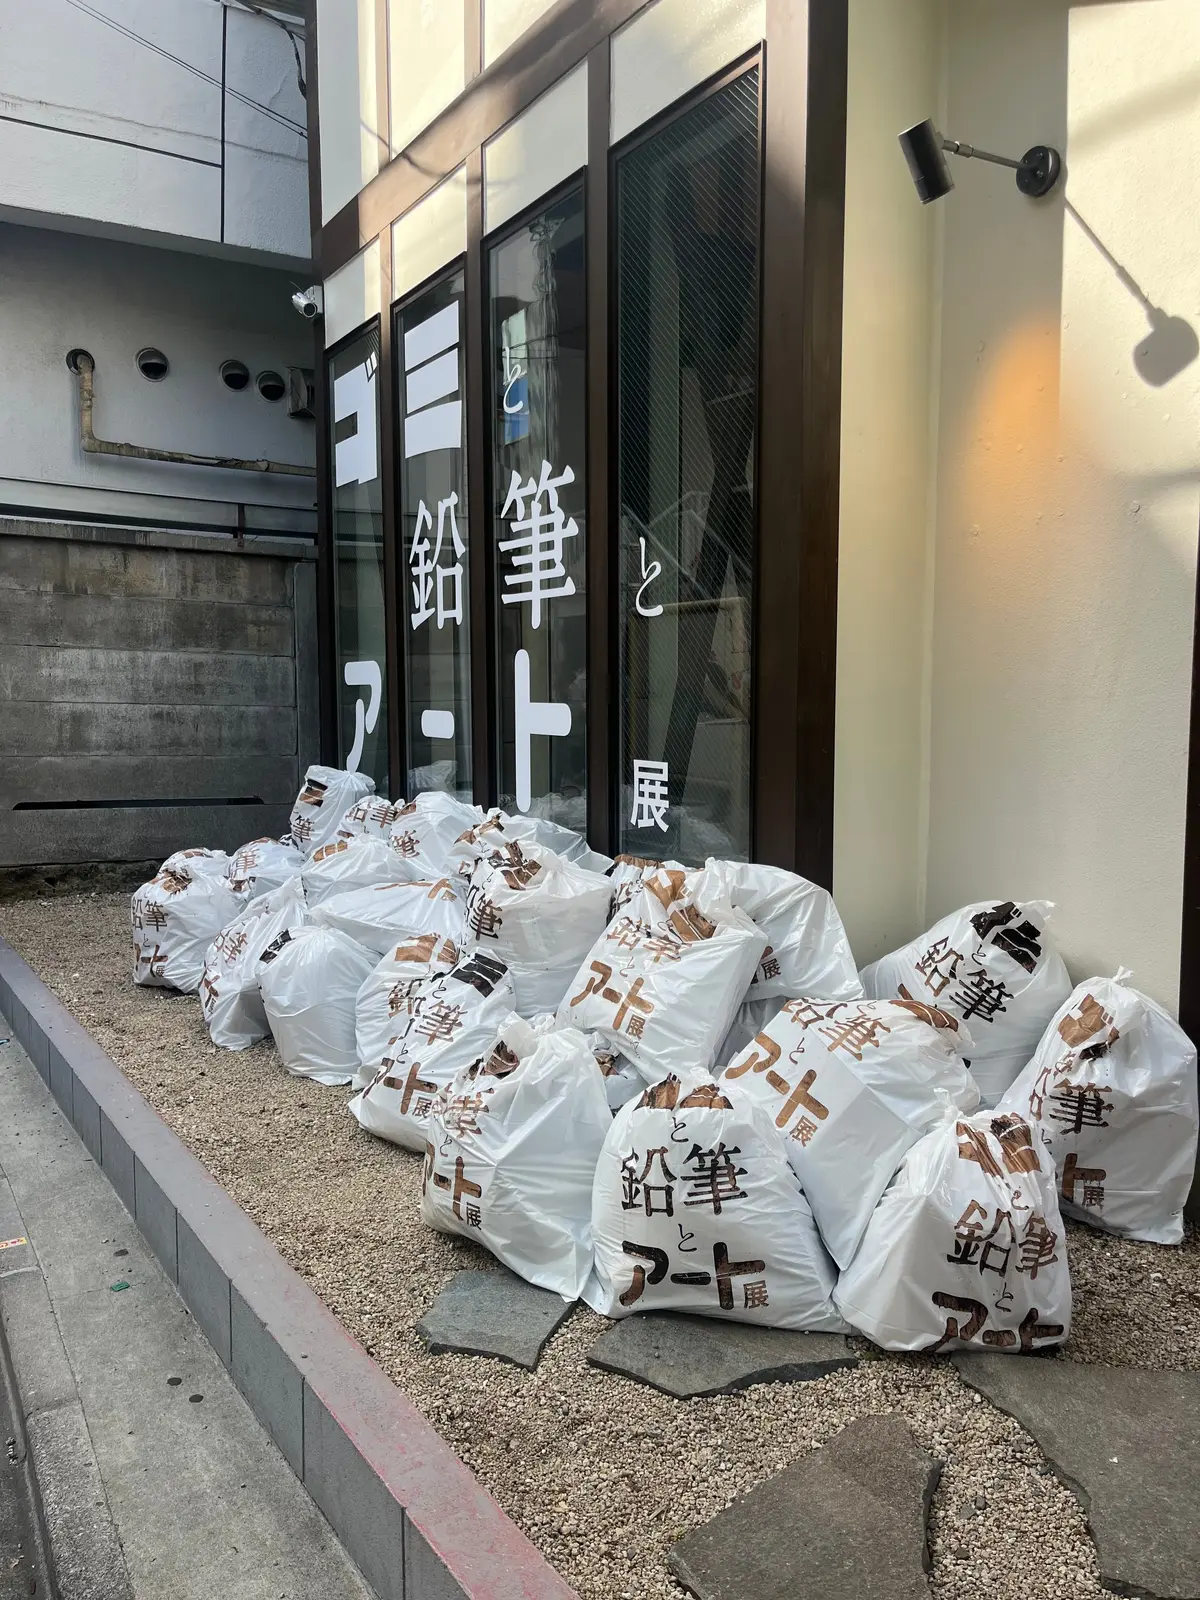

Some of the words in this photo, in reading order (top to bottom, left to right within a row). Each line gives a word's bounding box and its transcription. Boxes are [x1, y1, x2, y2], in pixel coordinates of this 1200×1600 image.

[670, 1116, 689, 1143] と
[620, 1142, 748, 1217] 鉛筆
[678, 1223, 698, 1252] と
[619, 1240, 769, 1311] アート展
